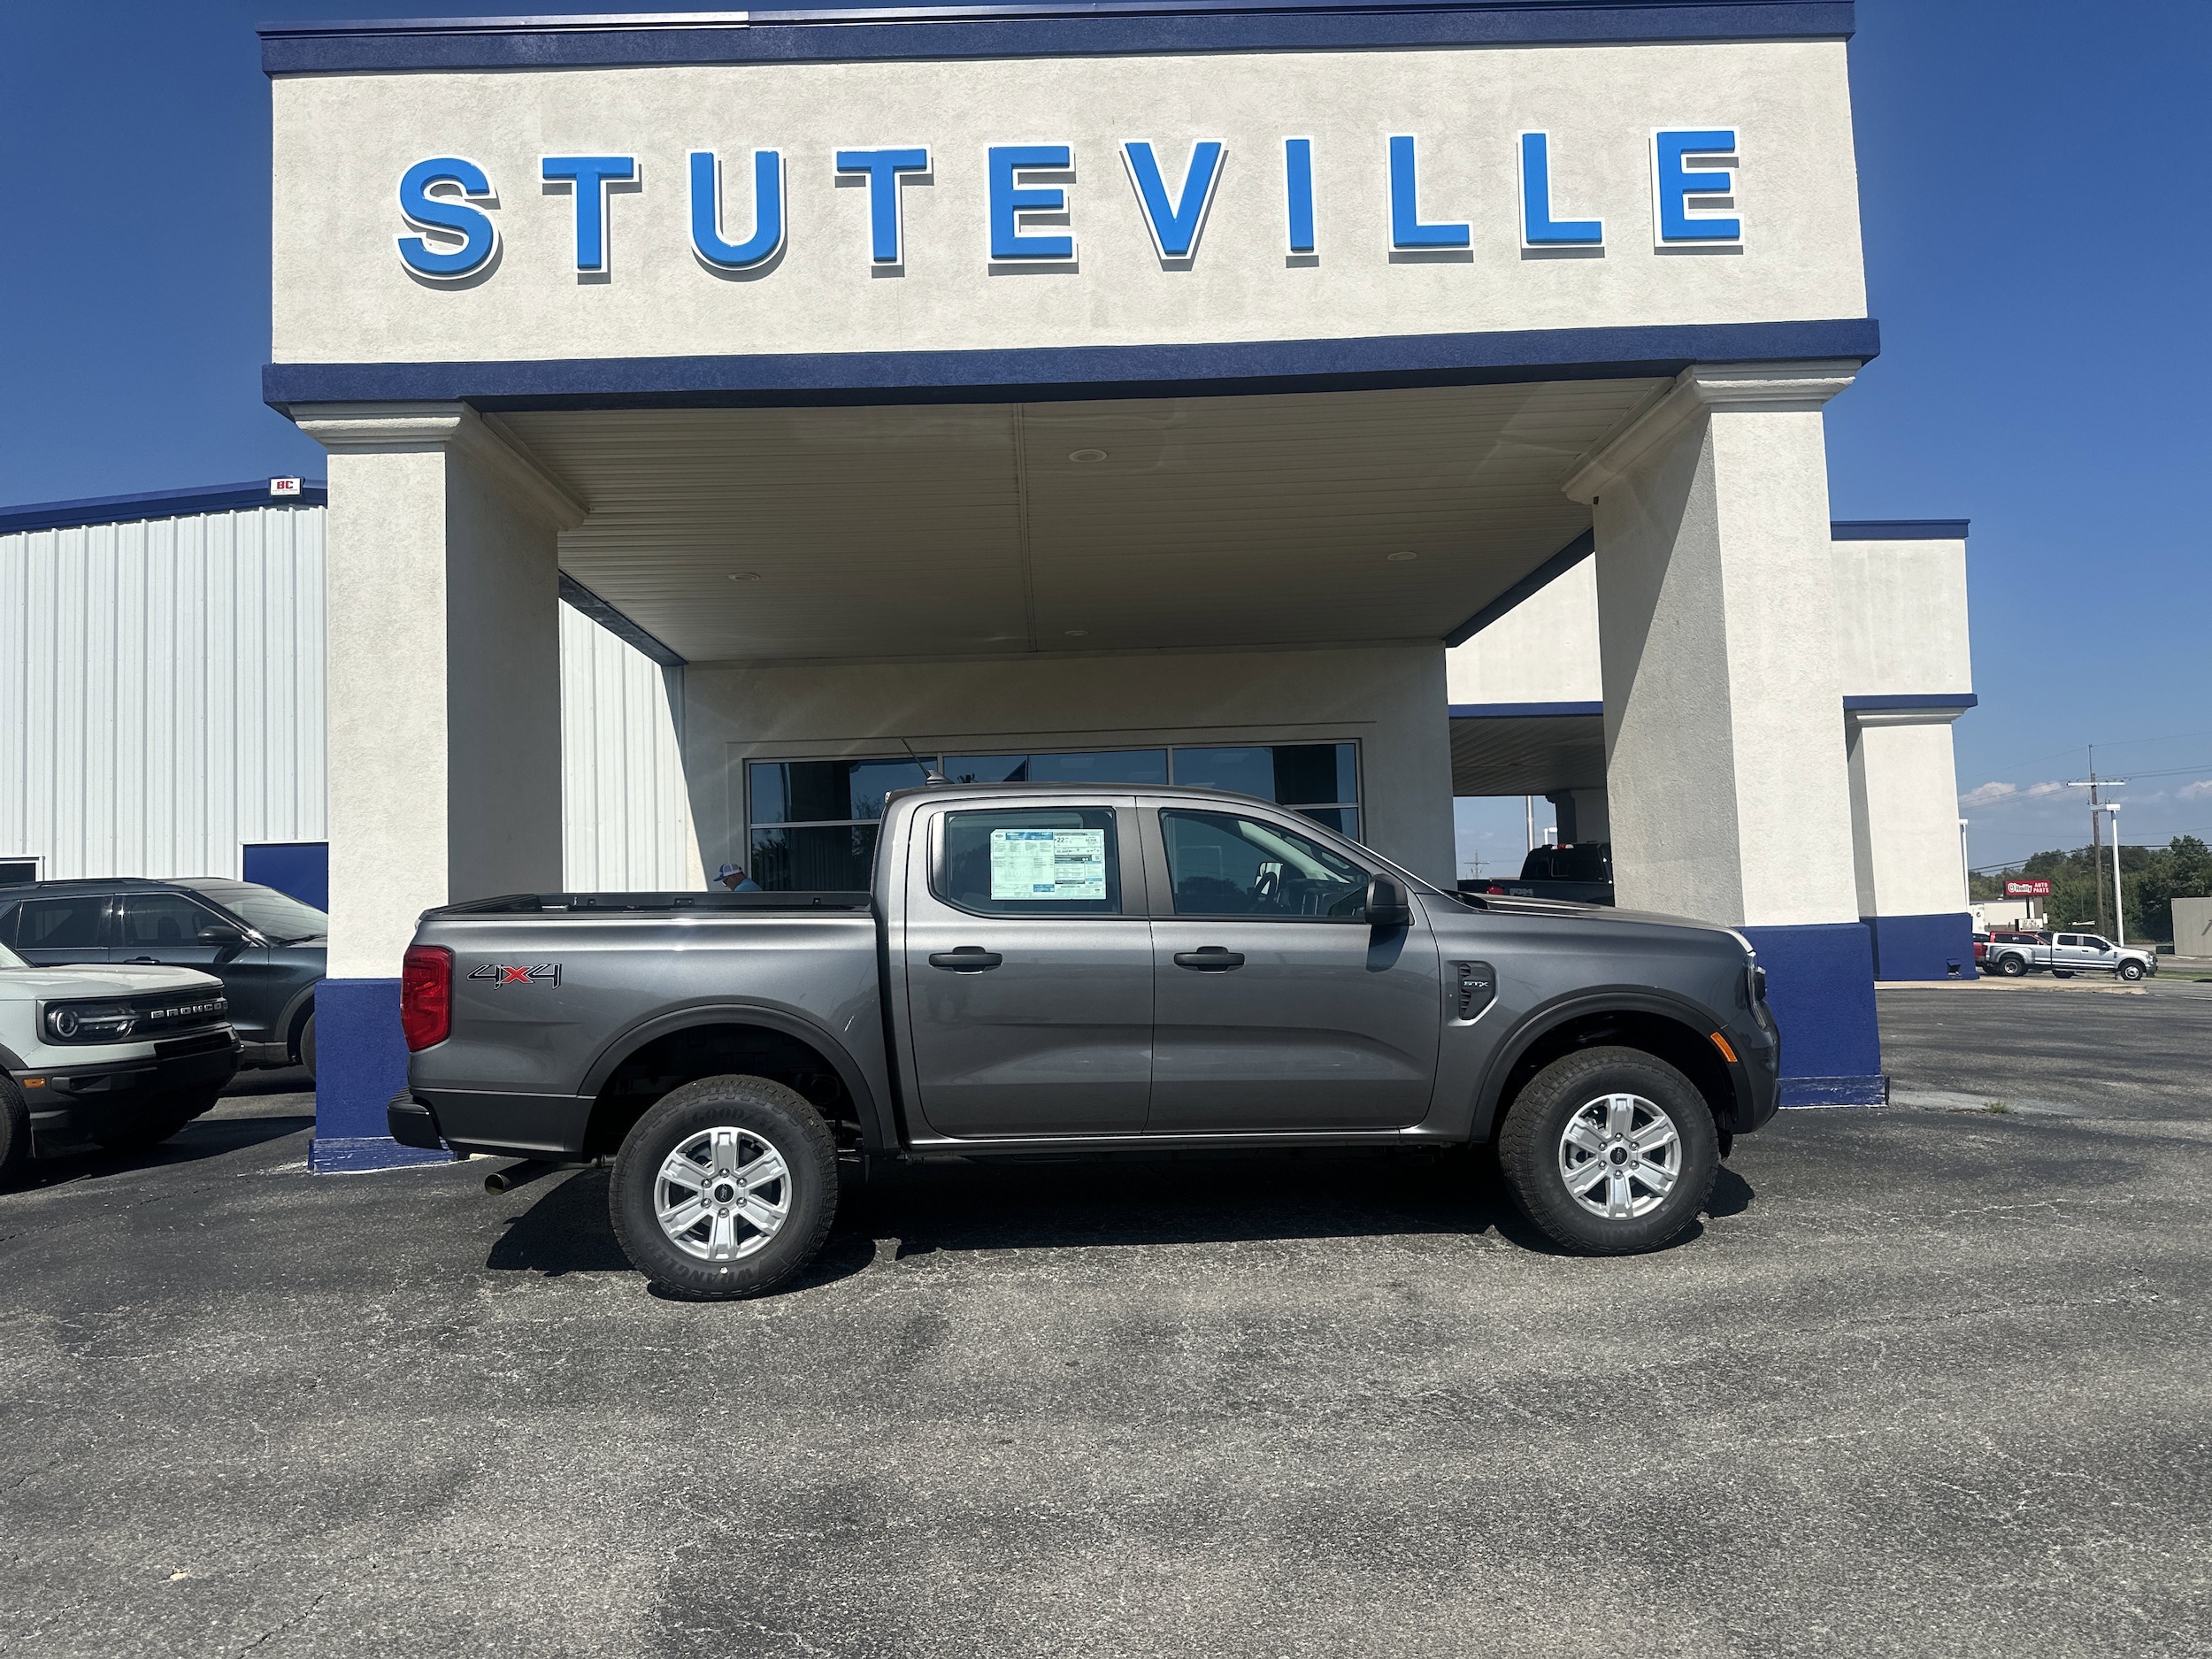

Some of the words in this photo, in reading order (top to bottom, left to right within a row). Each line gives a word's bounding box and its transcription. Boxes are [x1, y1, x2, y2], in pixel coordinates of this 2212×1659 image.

[396, 127, 1744, 277] STUTEVILLE
[277, 480, 294, 489] BC
[151, 1002, 222, 1018] BRONCO
